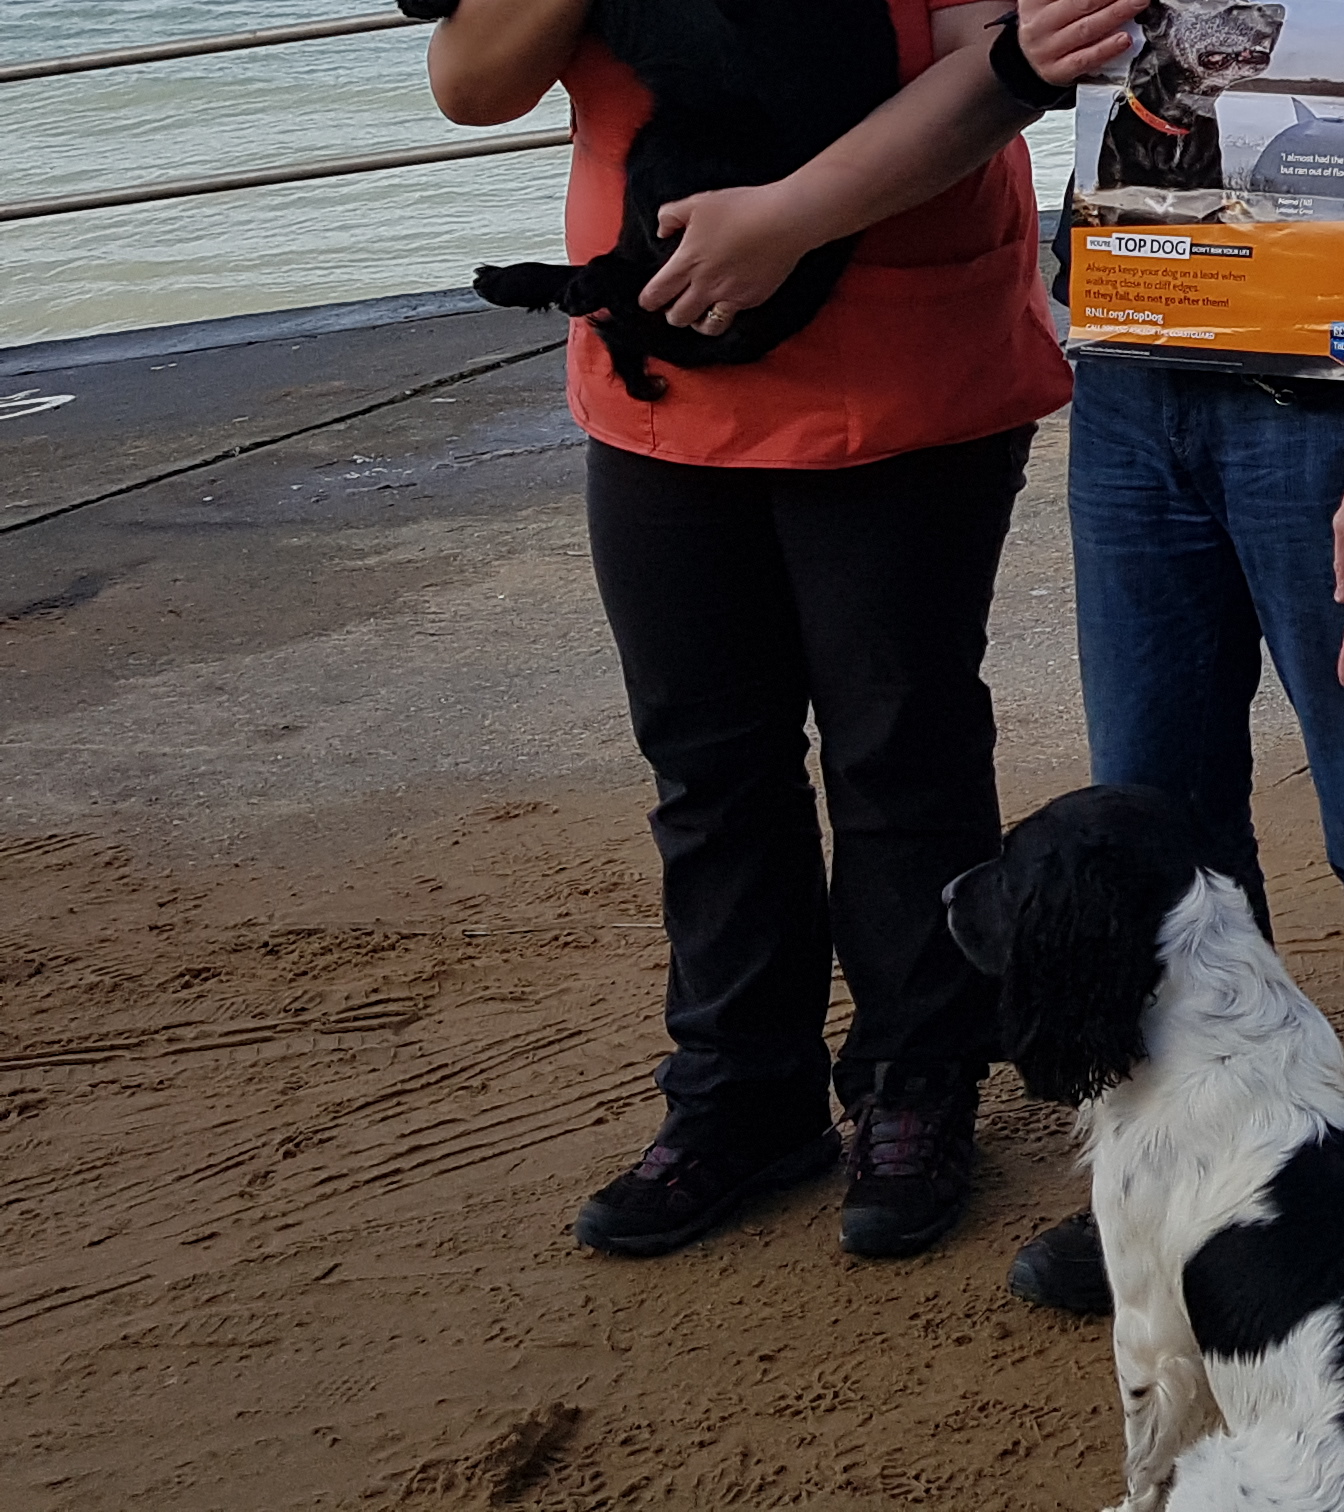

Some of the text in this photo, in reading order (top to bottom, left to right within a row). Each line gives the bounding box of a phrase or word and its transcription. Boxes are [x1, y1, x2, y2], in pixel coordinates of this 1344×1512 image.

[1315, 154, 1330, 163] had
[1331, 155, 1344, 164] the
[1280, 165, 1293, 174] but
[1309, 167, 1321, 176] out
[1115, 237, 1147, 252] TOP
[1150, 239, 1187, 255] DOG
[1118, 264, 1138, 277] keep
[1140, 268, 1160, 278] your
[1161, 267, 1178, 280] dog
[1200, 270, 1219, 280] lead
[1143, 280, 1153, 289] to
[1093, 289, 1113, 302] they
[1134, 292, 1145, 302] do
[1147, 295, 1163, 303] not
[1165, 296, 1176, 306] go
[1178, 294, 1200, 306] after
